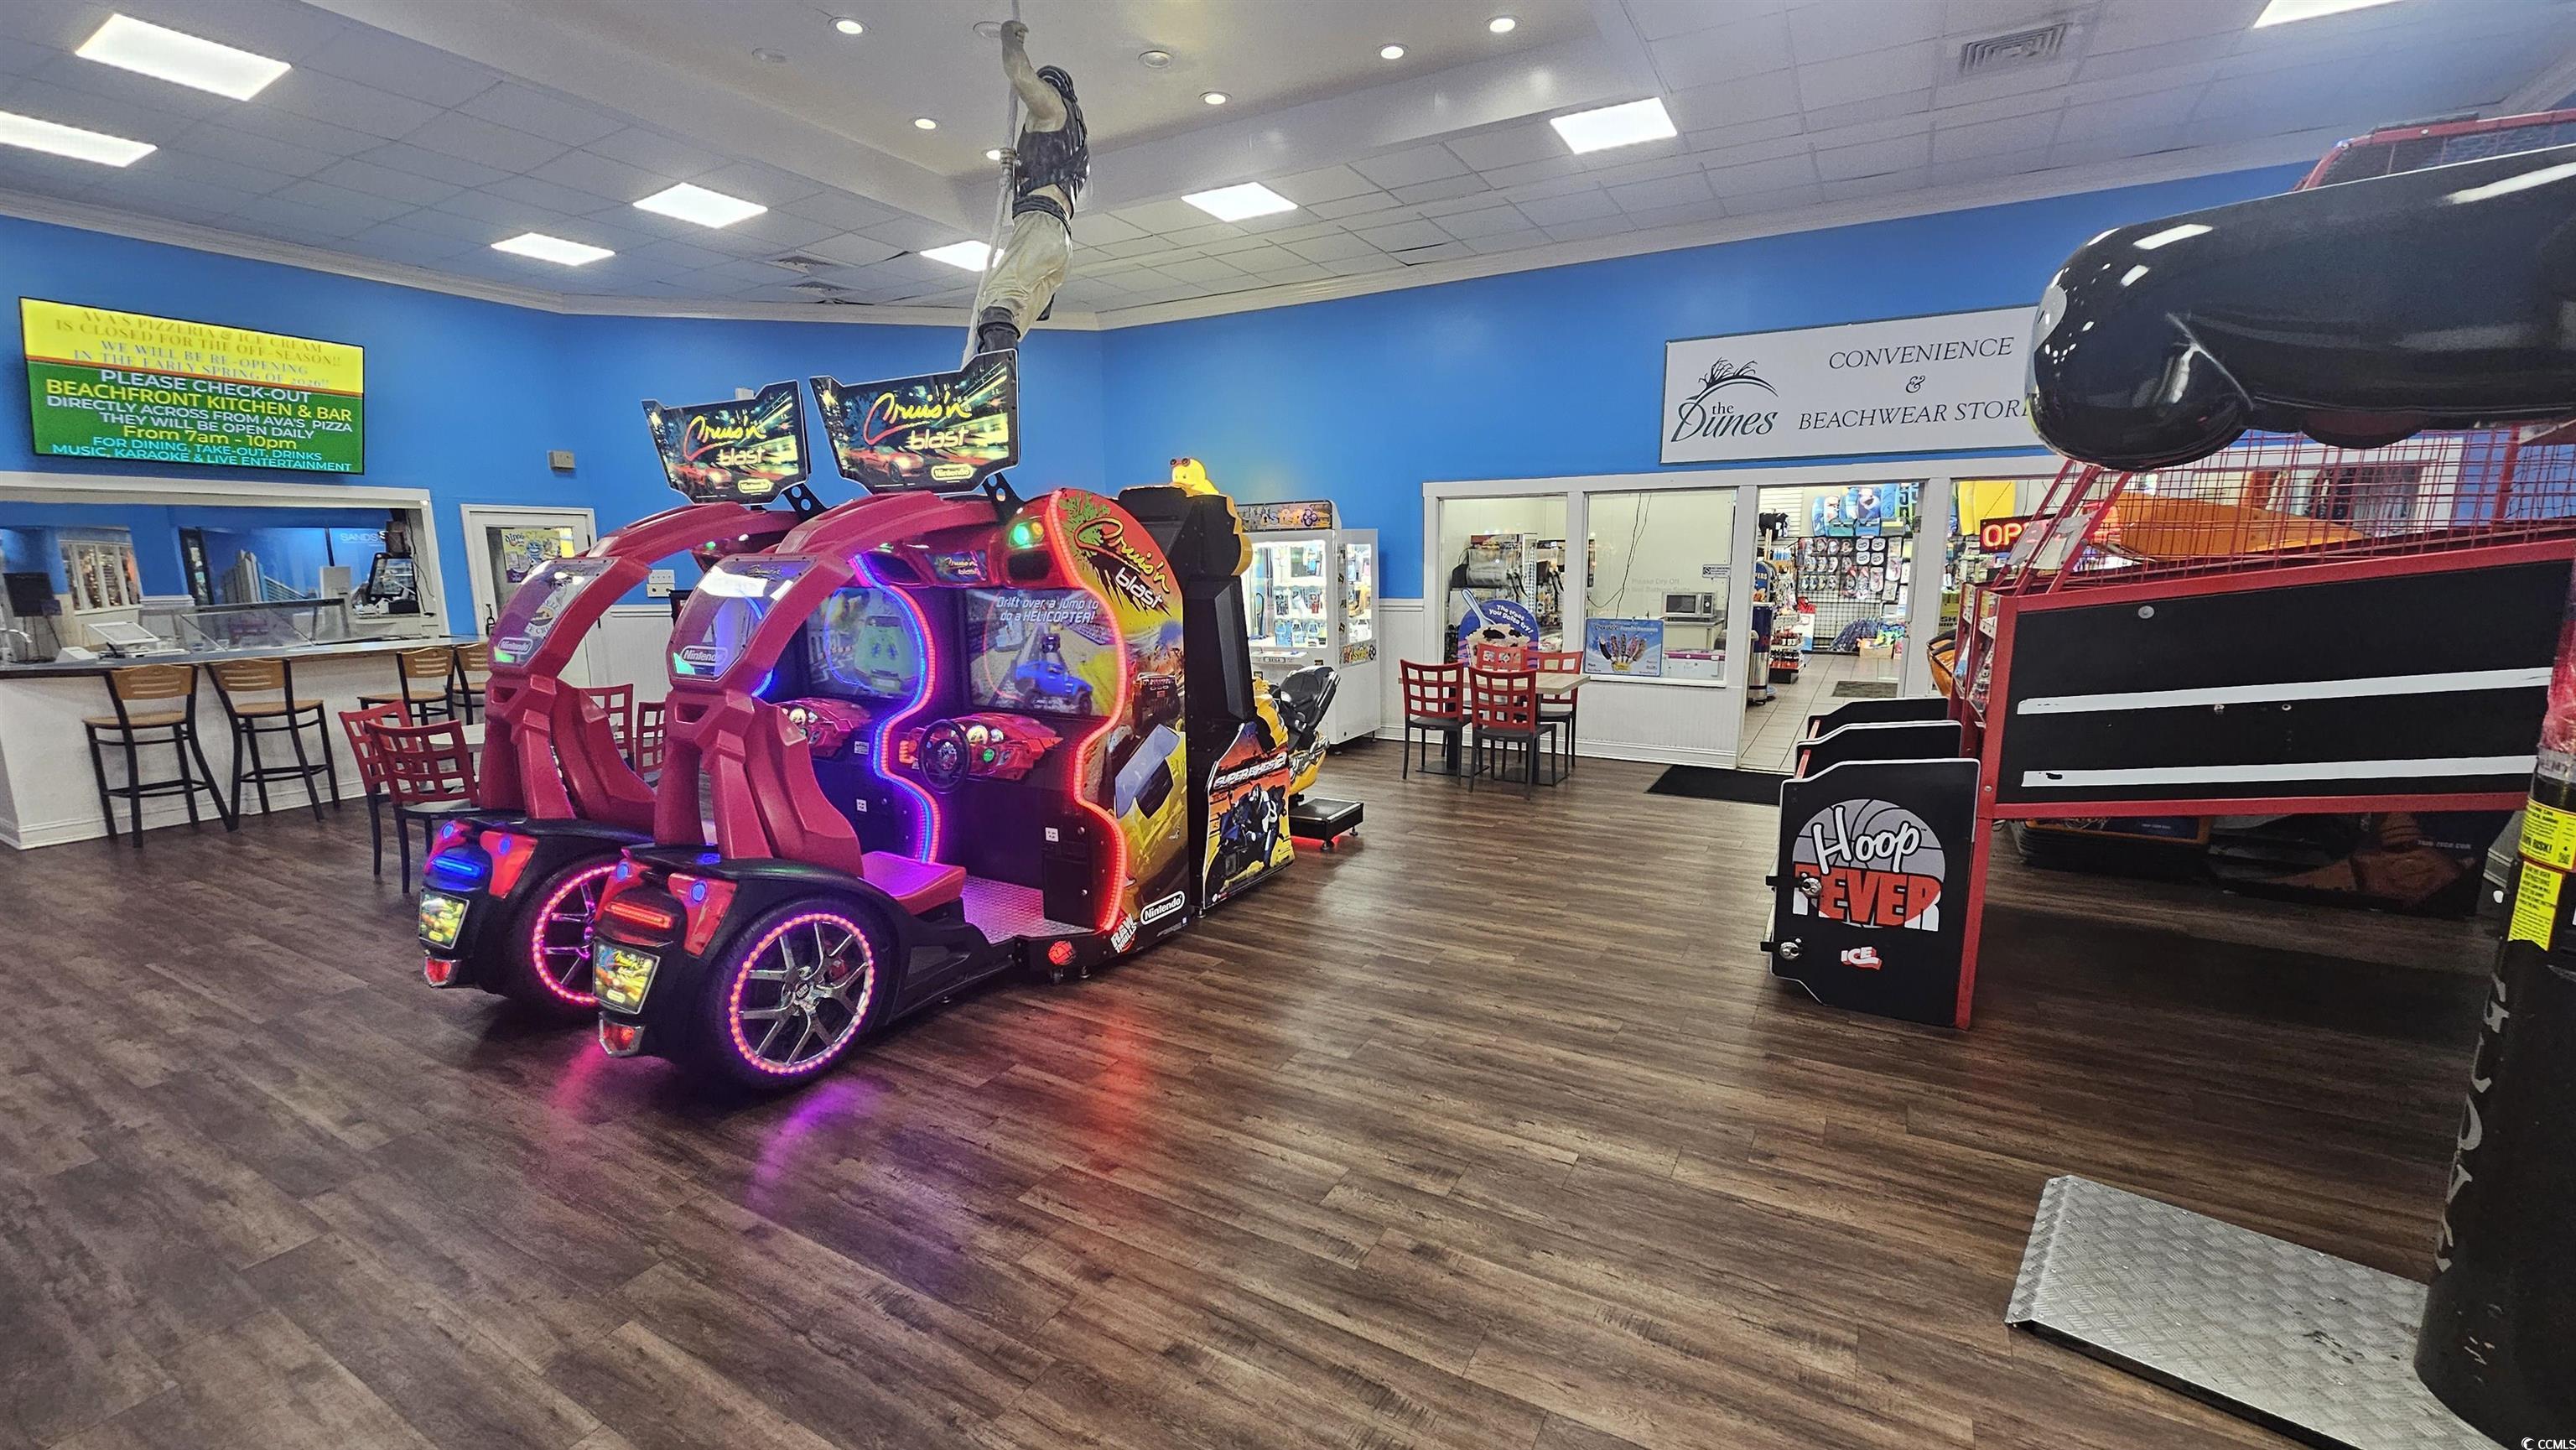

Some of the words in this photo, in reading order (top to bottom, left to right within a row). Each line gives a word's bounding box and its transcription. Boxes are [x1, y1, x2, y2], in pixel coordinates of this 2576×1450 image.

[55, 320, 73, 330] IS
[80, 321, 153, 342] CLOSED
[159, 334, 194, 347] FOR
[200, 339, 228, 351] THE
[84, 311, 131, 325] AVA'S
[138, 318, 214, 337] PIZZERIA
[240, 333, 262, 344] ICE
[270, 338, 322, 353] CREAM
[101, 340, 126, 351] WE
[135, 345, 177, 359] WILL
[184, 351, 202, 362] BE
[1829, 336, 2014, 370] CONVENIENCE
[74, 349, 92, 361] IN
[101, 353, 132, 366] THE
[143, 357, 196, 373] EARLY
[202, 365, 260, 380] SPRING
[265, 374, 283, 384] OF
[100, 369, 187, 391] PLEASE
[193, 380, 312, 403] CHECK-OUT
[1905, 375, 1926, 393] &
[45, 379, 201, 408] BEACHFRONT
[207, 395, 292, 416] KITCHEN
[298, 405, 312, 418] &
[317, 407, 352, 422] BAR
[1711, 402, 1735, 415] the
[47, 396, 138, 413] DIRECTLY
[141, 404, 209, 419] ACROSS
[213, 411, 259, 424] FROM
[263, 415, 305, 429] AVA'S
[313, 420, 352, 432] PIZZA
[100, 412, 147, 425] THEY
[150, 416, 193, 429] WILL
[197, 420, 219, 432] BE
[222, 423, 267, 435] OPEN
[272, 427, 314, 439] DAILY
[863, 390, 973, 445] Cruis'n
[1670, 402, 1779, 443] Dunes
[1798, 404, 1948, 430] BEACHWEAR
[93, 436, 126, 448] FOR
[273, 450, 322, 461] DRINKS
[123, 425, 179, 441] From
[184, 431, 229, 444] 7am
[246, 434, 297, 450] 10pm
[683, 414, 767, 462] Cruis'n
[907, 426, 969, 450] blast
[114, 449, 190, 462] KARAOKE
[194, 454, 203, 463] &
[206, 455, 237, 465] LIVE
[242, 457, 352, 471] ENTERTAINMENT
[717, 446, 766, 465] blast
[935, 468, 971, 479] Nintendo
[1074, 517, 1171, 594] Cruis'n
[1114, 566, 1163, 609] blast
[996, 596, 1020, 608] Drift
[1022, 600, 1045, 609] over
[1049, 600, 1057, 609] a
[1088, 598, 1099, 609] to
[1000, 611, 1012, 621] do
[1015, 614, 1021, 622] a
[1022, 611, 1096, 624] HELICOPTER!
[683, 649, 723, 663] Nintend
[1213, 767, 1249, 788] SUPER
[1812, 806, 1920, 875] Hoop
[1144, 895, 1182, 921] Nintendo
[1793, 862, 1941, 932] FEVER
[1841, 947, 1882, 970] ICE
